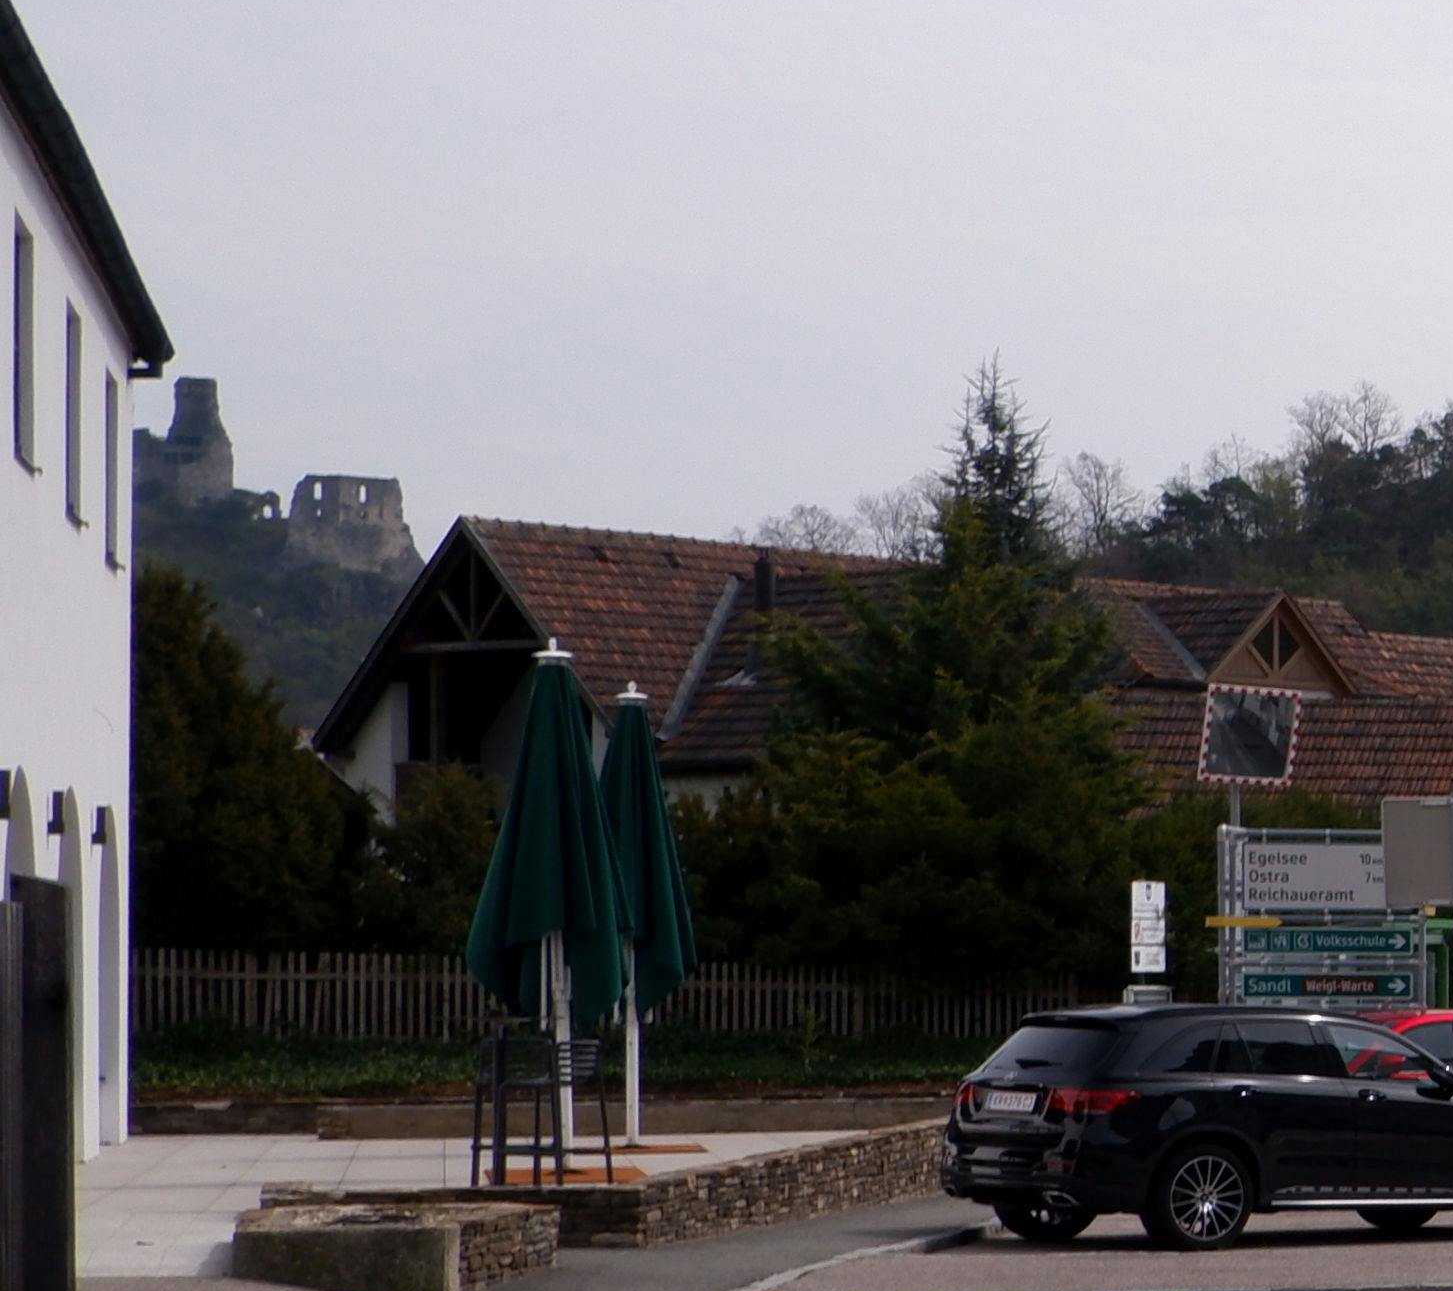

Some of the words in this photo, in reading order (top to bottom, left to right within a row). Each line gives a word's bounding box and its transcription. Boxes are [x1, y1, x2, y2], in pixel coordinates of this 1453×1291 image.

[1249, 851, 1308, 867] Egelsee
[1359, 853, 1372, 865] 10
[1249, 869, 1290, 884] Ostra
[1365, 871, 1372, 883] 7
[1249, 887, 1355, 902] Reichaueramt
[1315, 934, 1387, 948] Volksschule
[1249, 978, 1292, 993] Sandl
[1305, 979, 1375, 994] Weigl-Warte
